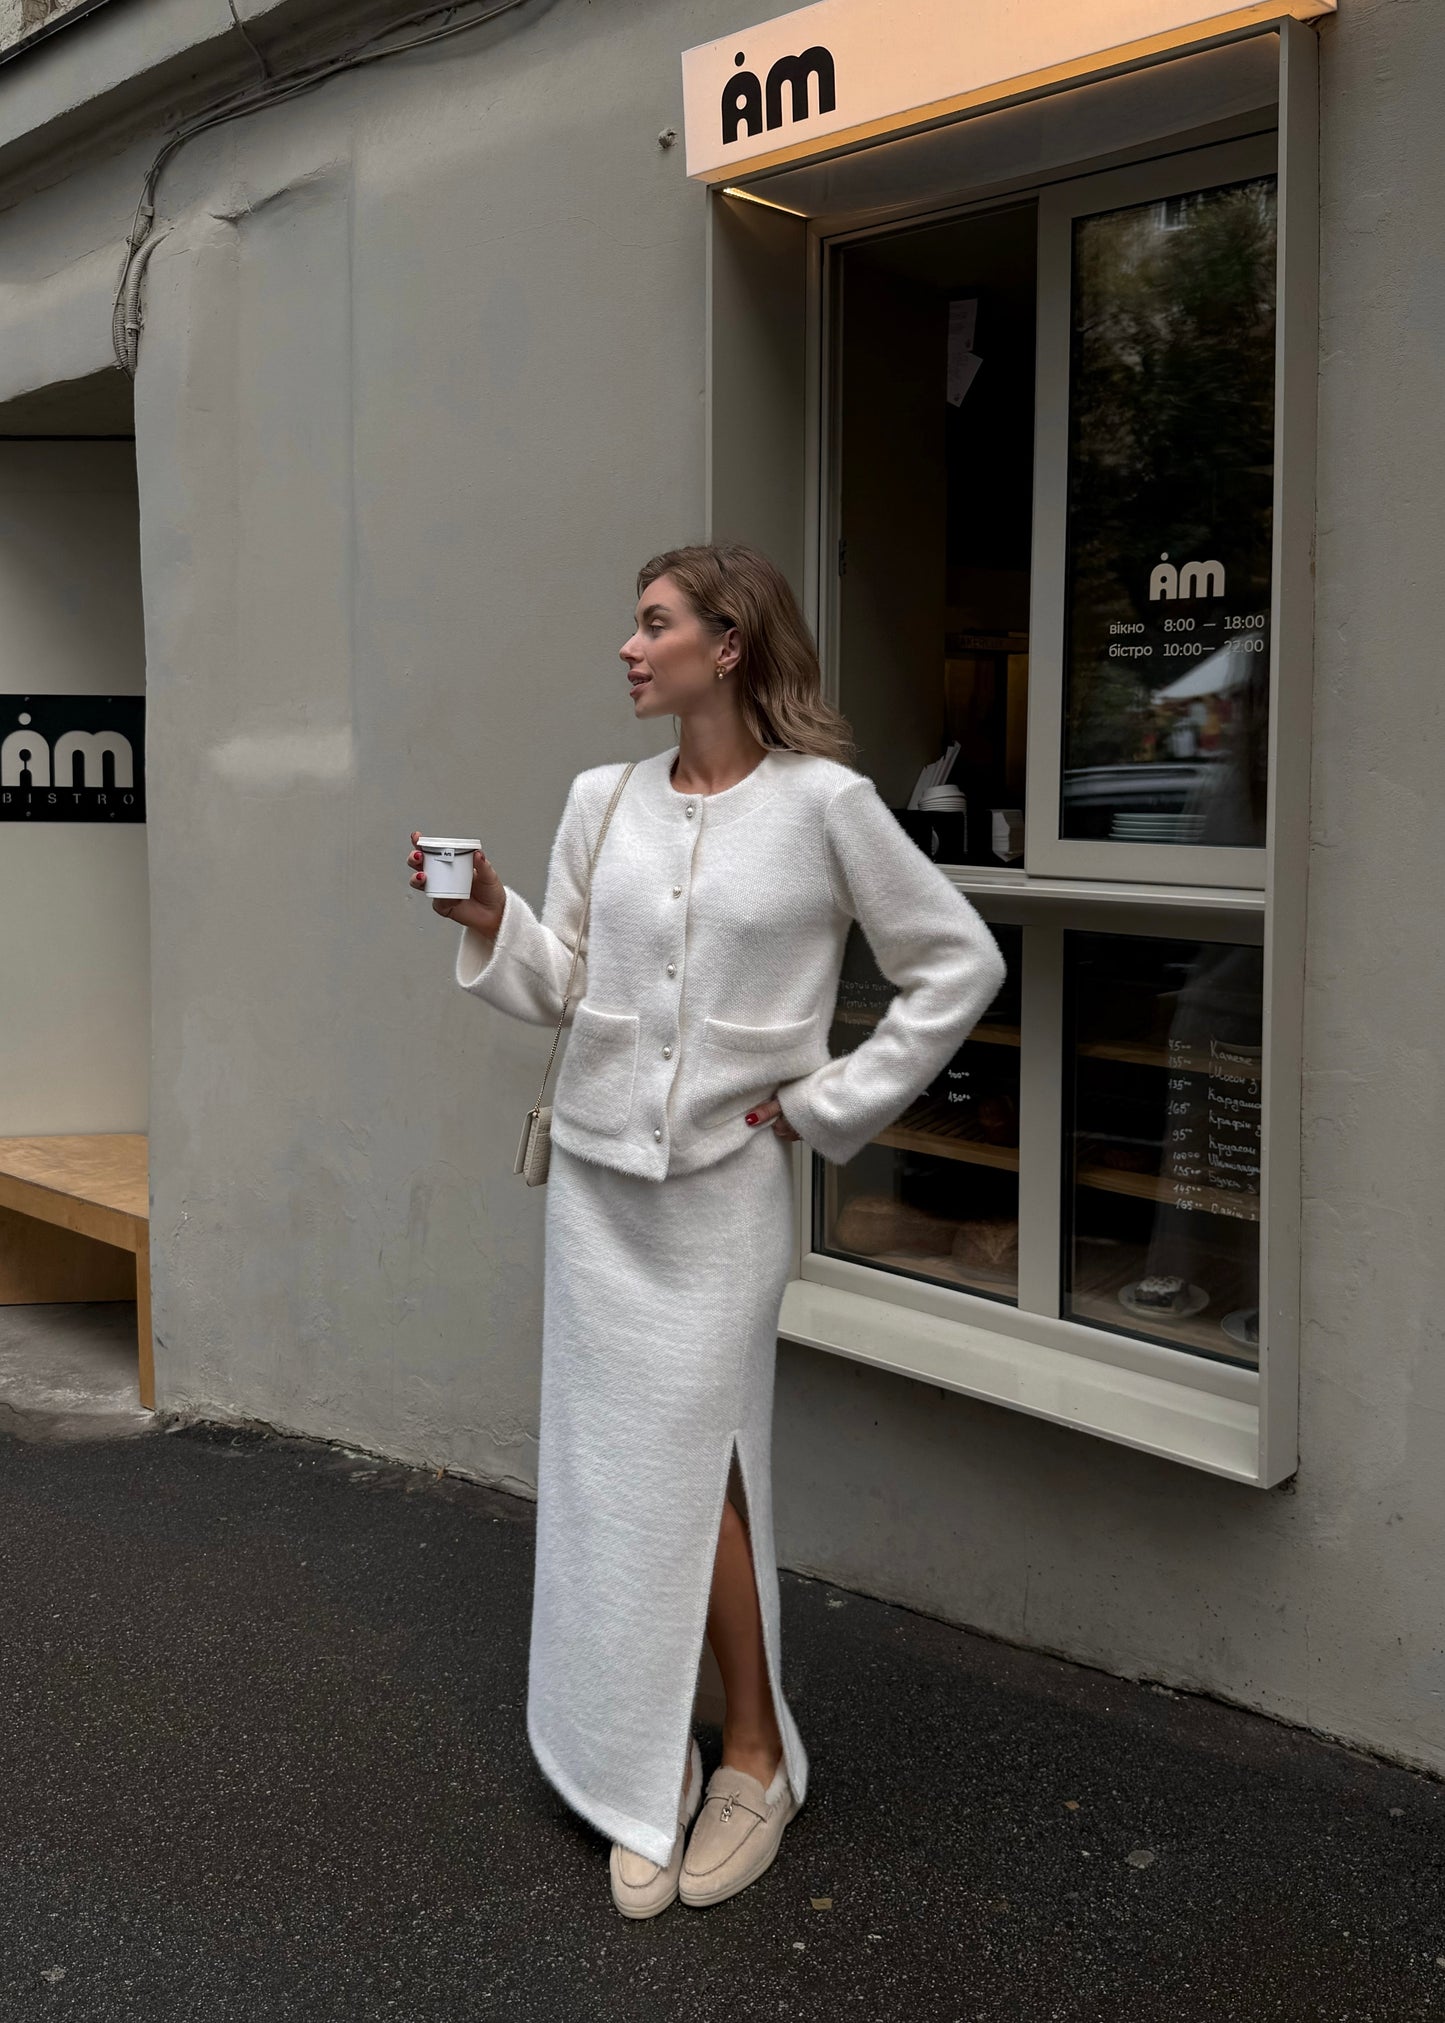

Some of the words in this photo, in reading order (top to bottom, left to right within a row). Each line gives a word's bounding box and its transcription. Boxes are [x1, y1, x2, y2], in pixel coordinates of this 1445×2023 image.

[1109, 621, 1145, 635] вікно
[1163, 618, 1196, 632] 8:00
[1223, 615, 1265, 630] 18:00
[1108, 643, 1153, 659] бістро
[2, 792, 135, 805] BISTRO
